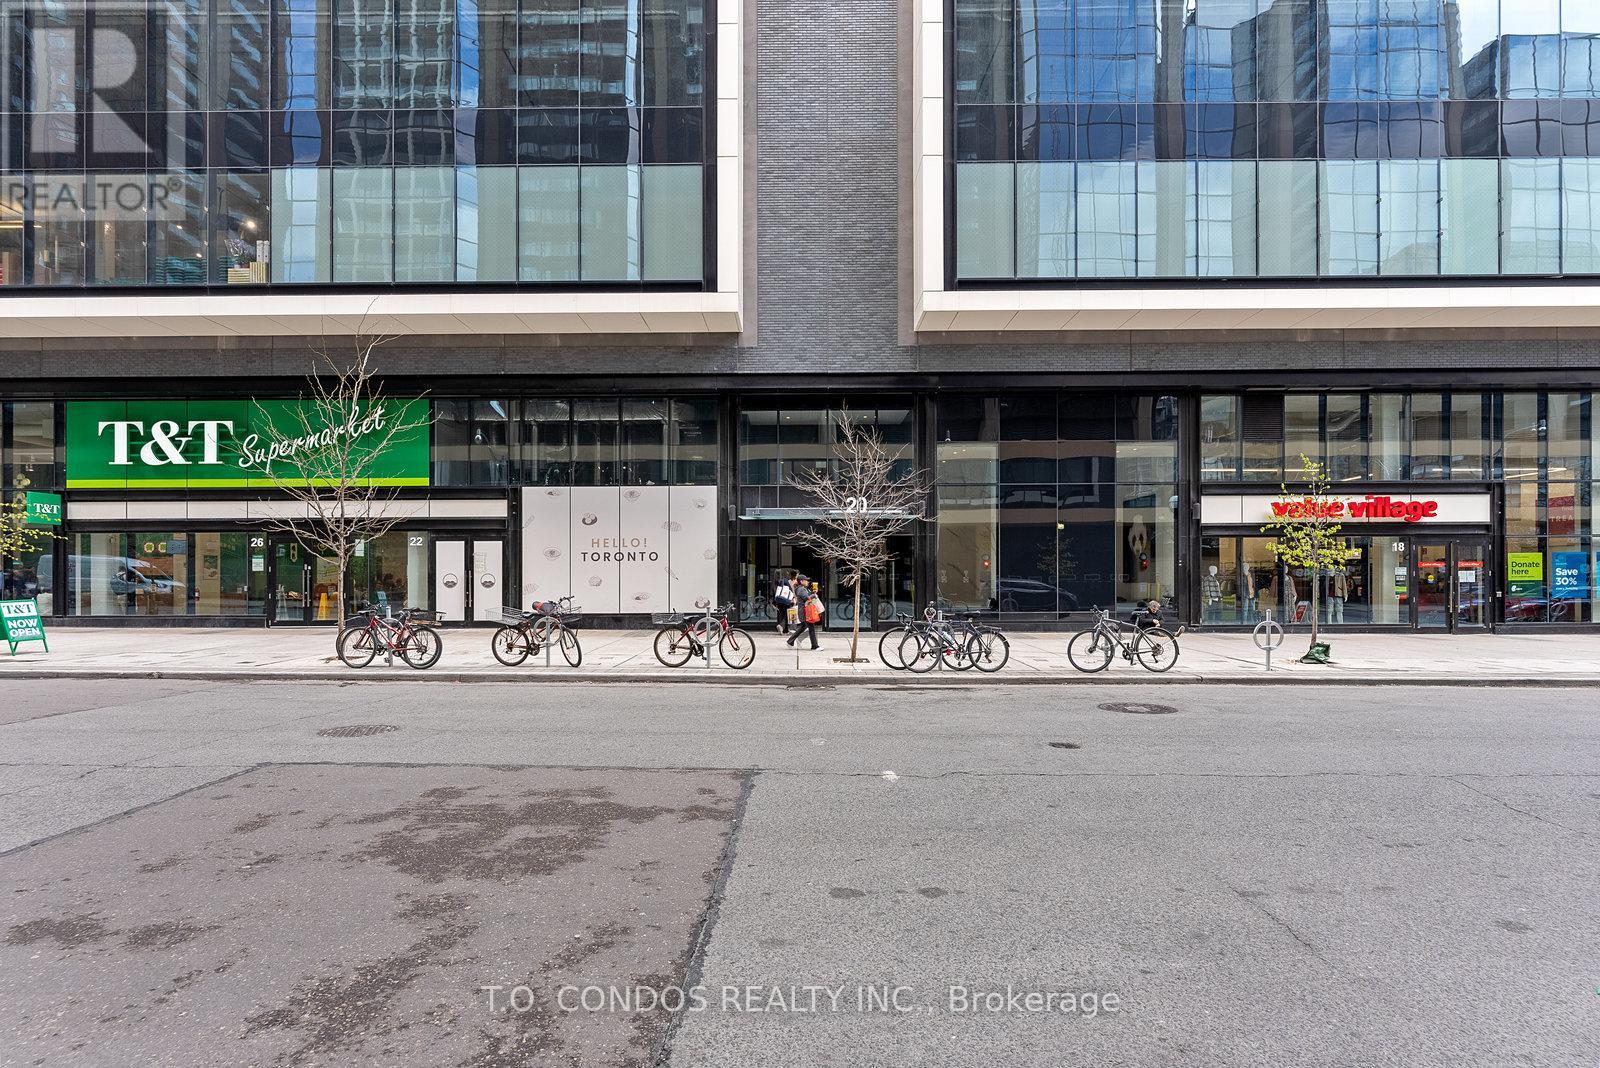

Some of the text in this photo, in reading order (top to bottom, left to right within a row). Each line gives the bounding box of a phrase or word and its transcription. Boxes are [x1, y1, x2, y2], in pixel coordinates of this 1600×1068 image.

[98, 405, 386, 474] T&T Supermarket
[33, 502, 61, 514] T&T
[846, 496, 868, 513] 20
[1271, 495, 1438, 522] value village
[250, 538, 264, 547] 26
[409, 537, 423, 547] 22
[591, 537, 647, 548] HELLO!
[1392, 542, 1405, 552] 18
[581, 551, 659, 562] TORONTO
[1511, 568, 1529, 576] here
[1555, 567, 1578, 576] Save
[1555, 577, 1578, 586] 30%
[2, 603, 34, 615] T&T
[6, 618, 39, 629] NOW
[9, 627, 41, 638] OPEN
